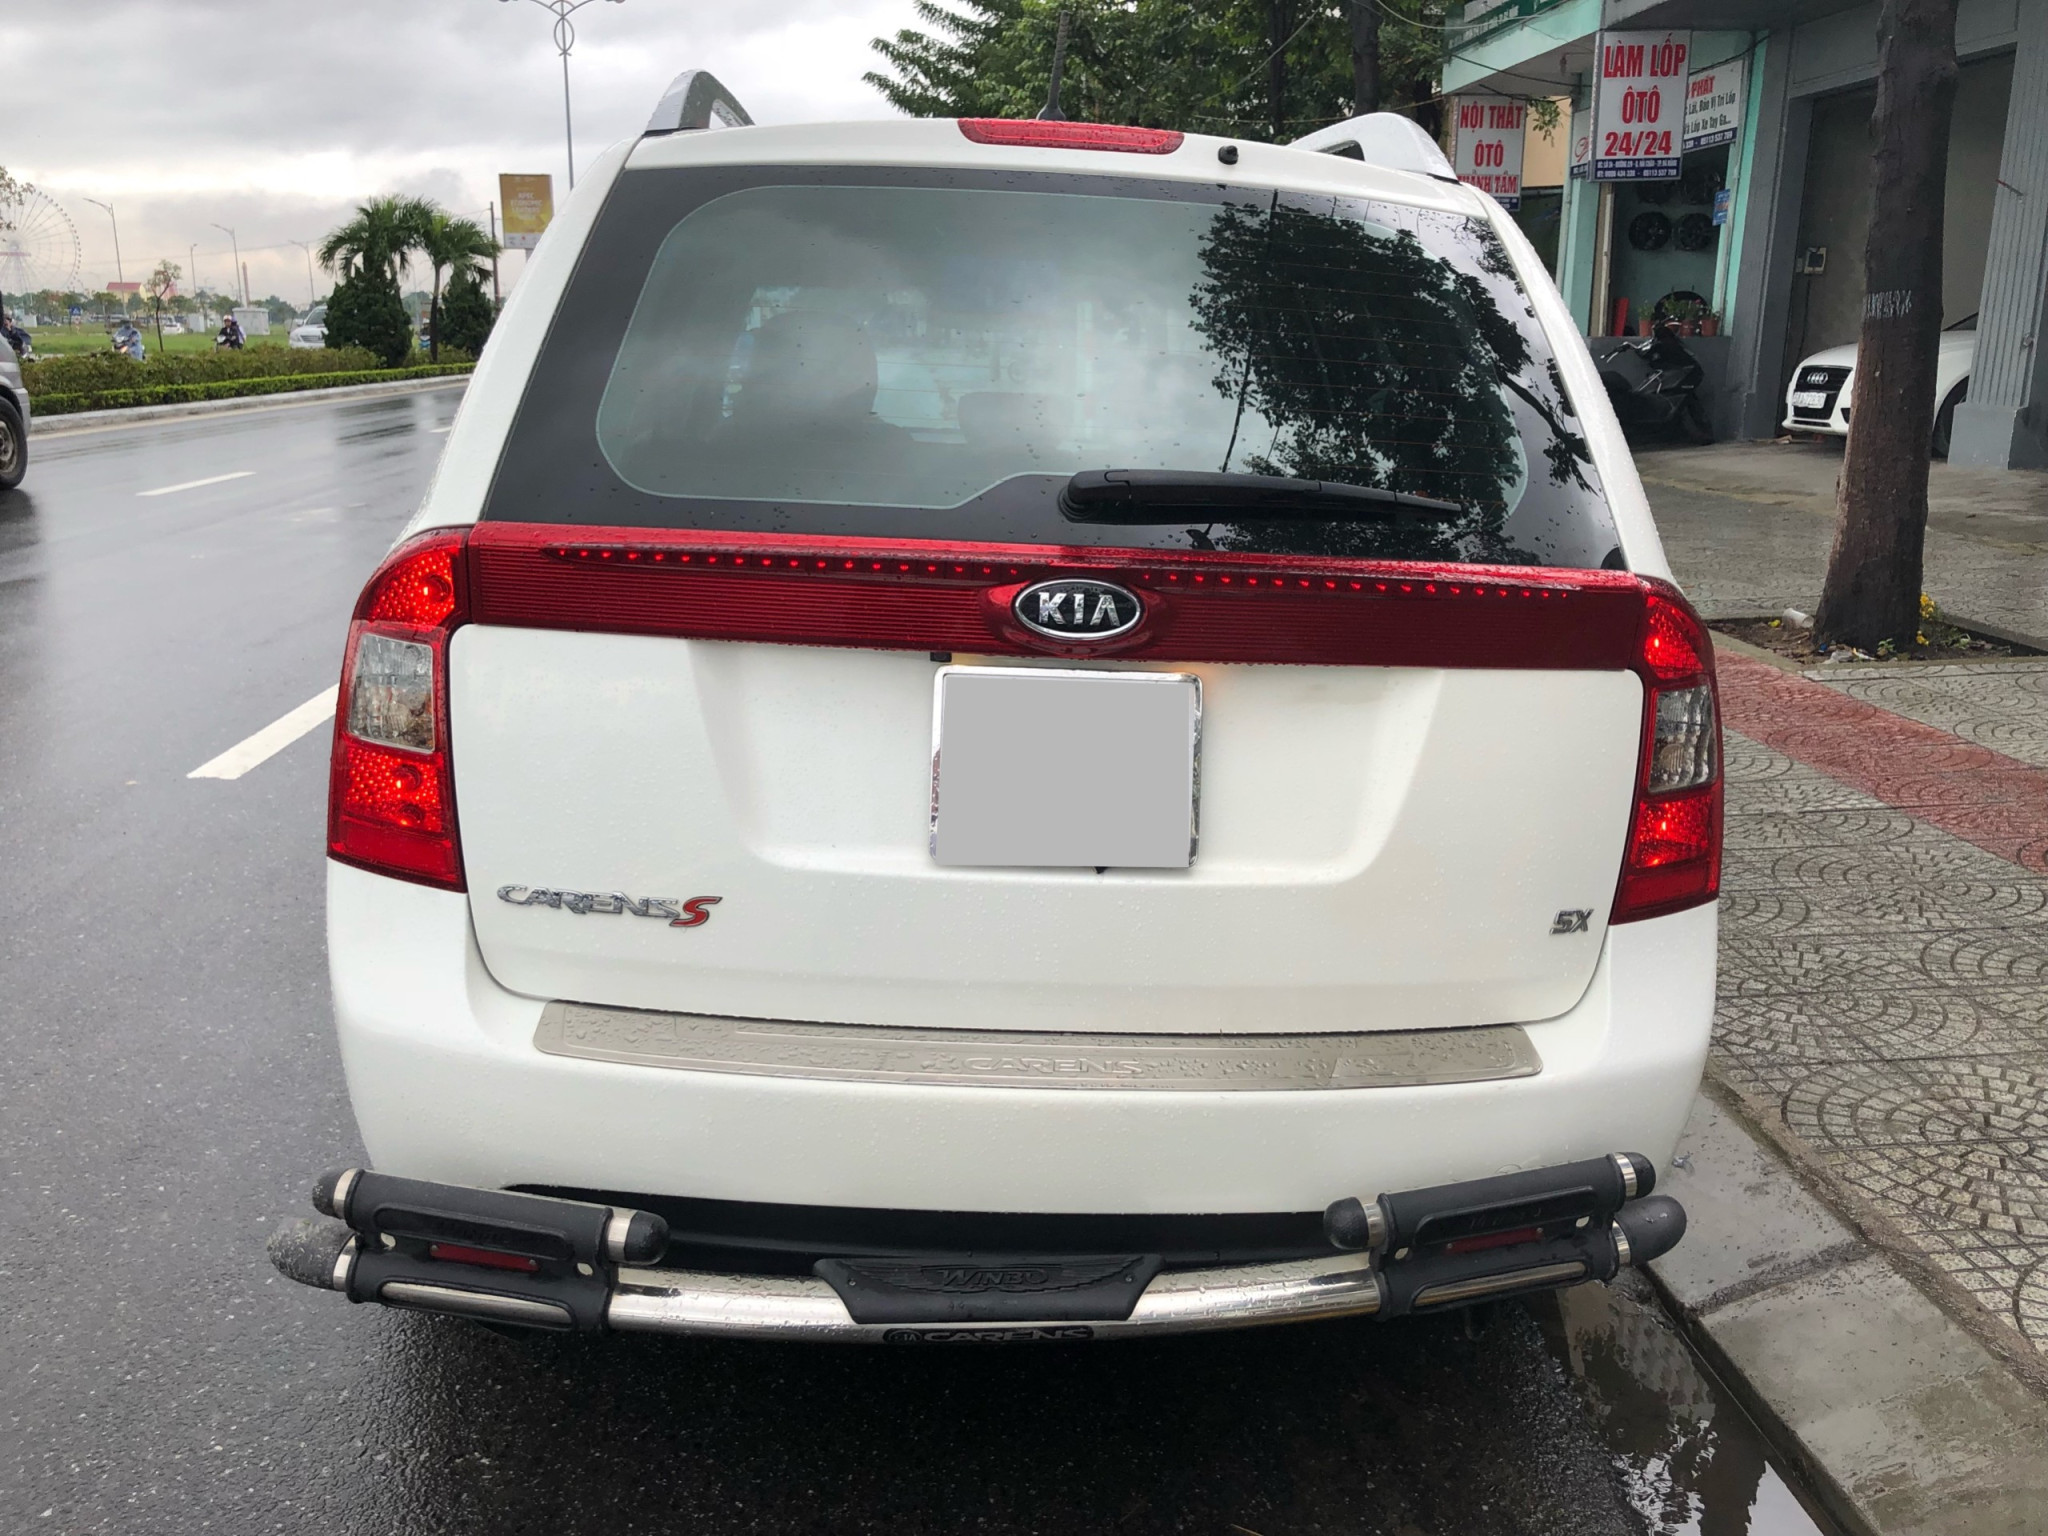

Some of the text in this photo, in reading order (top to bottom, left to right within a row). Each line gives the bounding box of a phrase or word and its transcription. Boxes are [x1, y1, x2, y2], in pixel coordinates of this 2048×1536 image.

[1604, 32, 1686, 78] LÀM LỐP
[1460, 101, 1484, 133] NỘI
[1622, 85, 1660, 124] ÔTÔ
[1474, 140, 1504, 167] ÔTÔ
[1604, 130, 1672, 156] 24/24
[1038, 592, 1120, 626] KIA
[1549, 908, 1594, 935] SX
[963, 1057, 1142, 1075] CARENS
[937, 1268, 1049, 1287] WINBO
[924, 1327, 1089, 1343] CARENS
